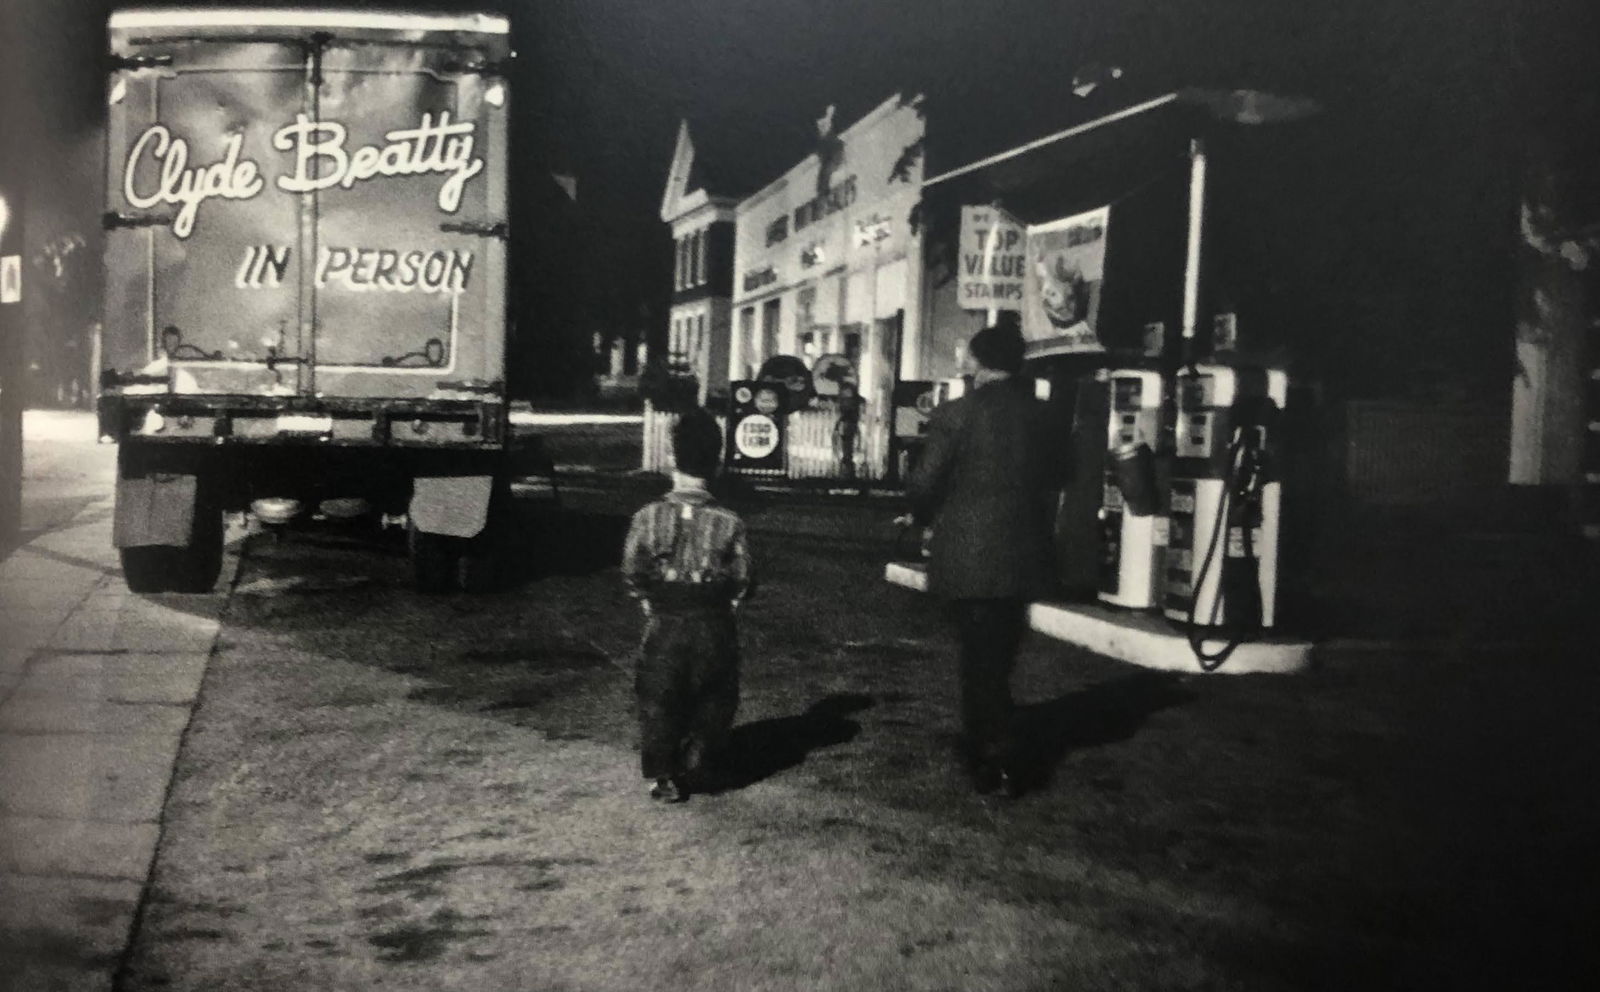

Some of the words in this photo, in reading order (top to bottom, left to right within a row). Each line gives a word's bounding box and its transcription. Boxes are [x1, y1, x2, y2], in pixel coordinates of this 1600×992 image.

[124, 125, 263, 238] Clyde
[273, 111, 483, 212] Beatty
[236, 246, 291, 289] IN
[315, 246, 474, 293] PERSON
